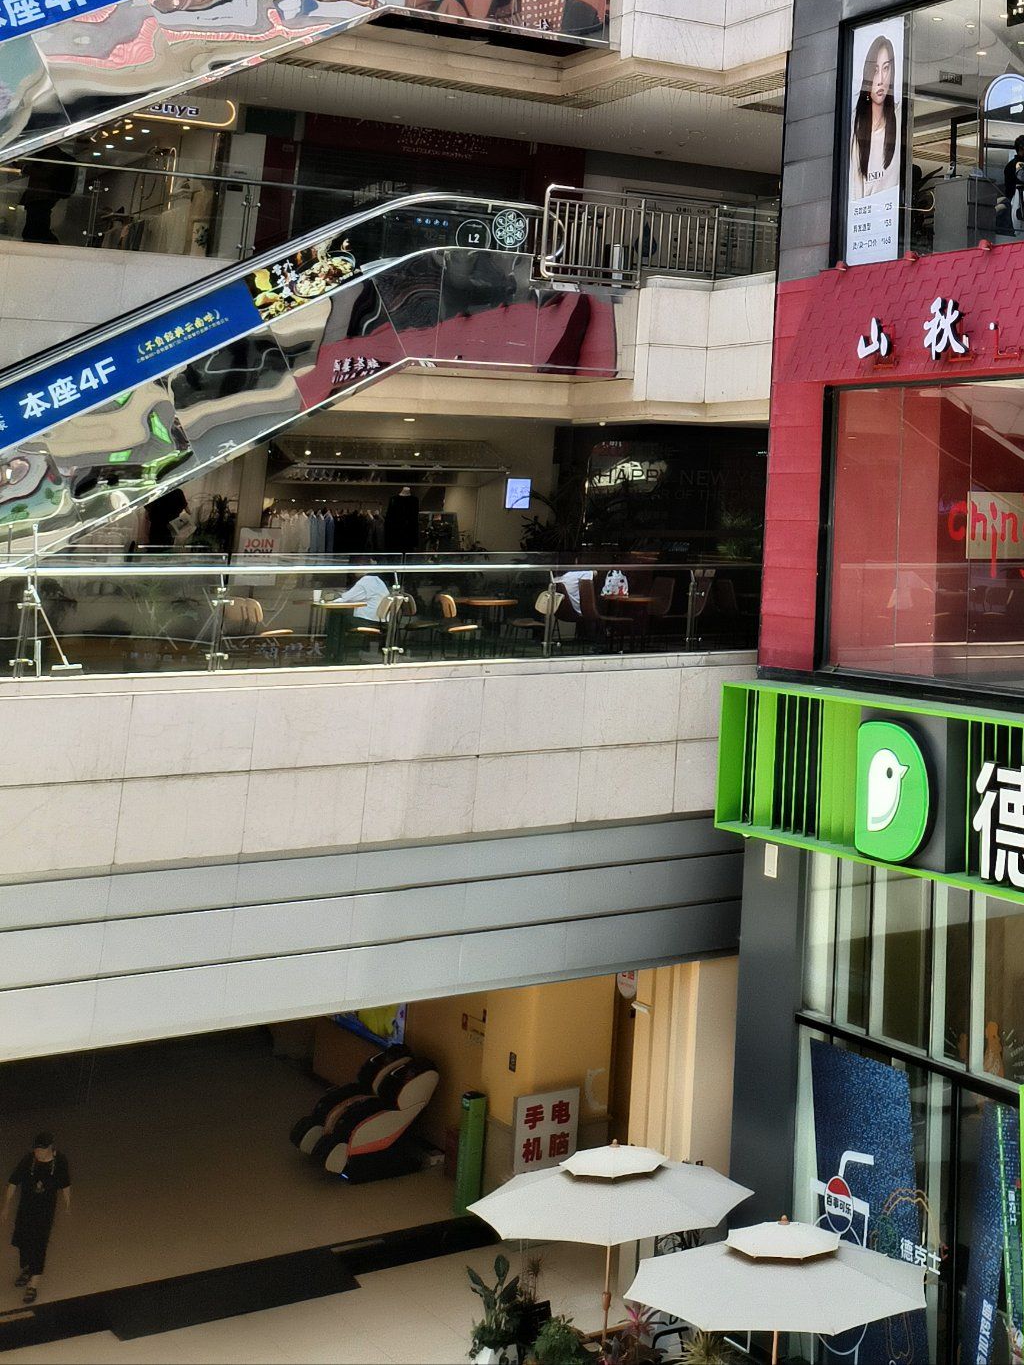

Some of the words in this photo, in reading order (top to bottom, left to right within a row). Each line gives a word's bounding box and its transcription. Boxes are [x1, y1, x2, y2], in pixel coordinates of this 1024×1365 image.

[468, 233, 480, 243] L2
[18, 356, 117, 420] 本座4F
[244, 538, 274, 549] JOIN
[826, 1196, 852, 1216] 百事可乐
[900, 1237, 941, 1275] 德克士
